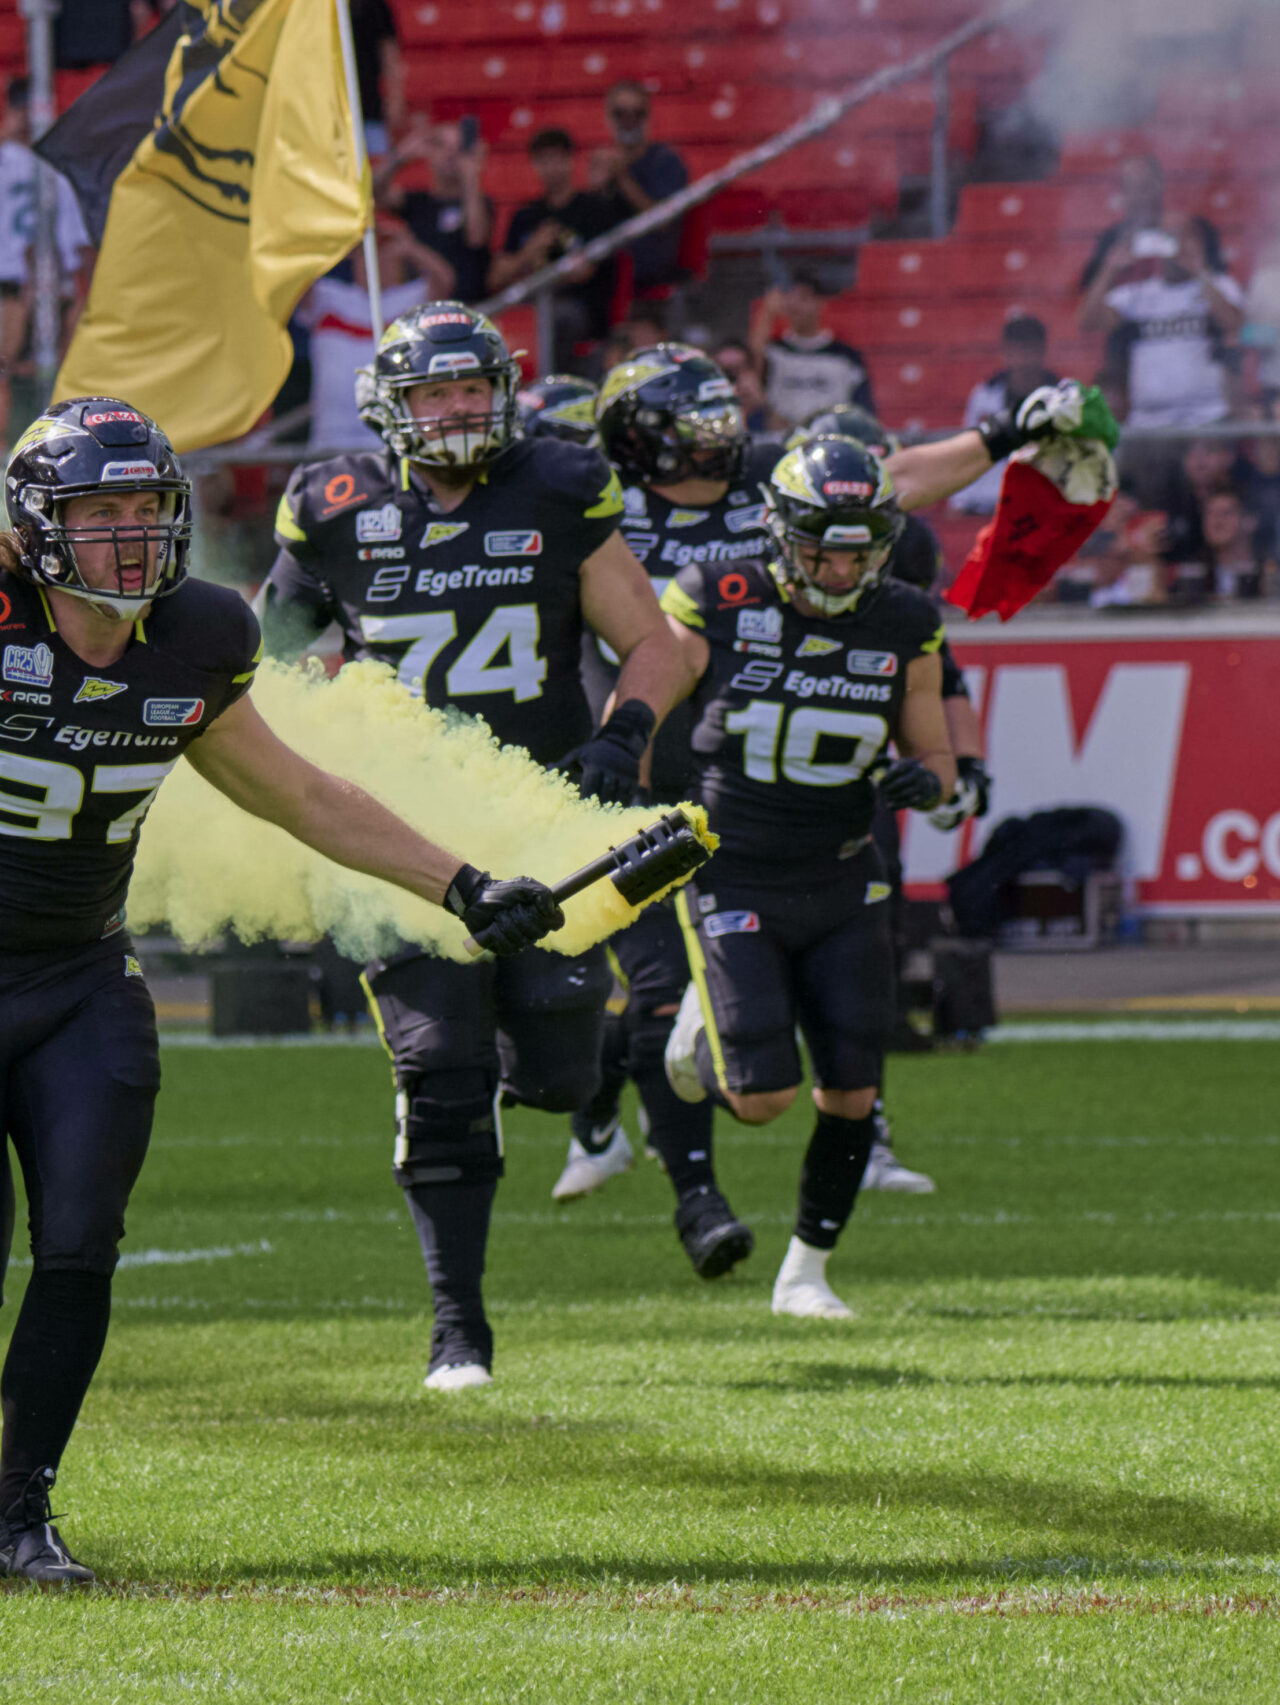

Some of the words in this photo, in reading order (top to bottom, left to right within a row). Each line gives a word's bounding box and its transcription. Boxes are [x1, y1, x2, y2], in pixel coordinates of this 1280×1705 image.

[91, 411, 141, 424] GAZI
[660, 536, 766, 566] EgeTrans
[415, 565, 534, 597] EgeTrans
[360, 603, 548, 704] 74
[784, 671, 892, 701] EgeTrans
[726, 699, 888, 787] 10
